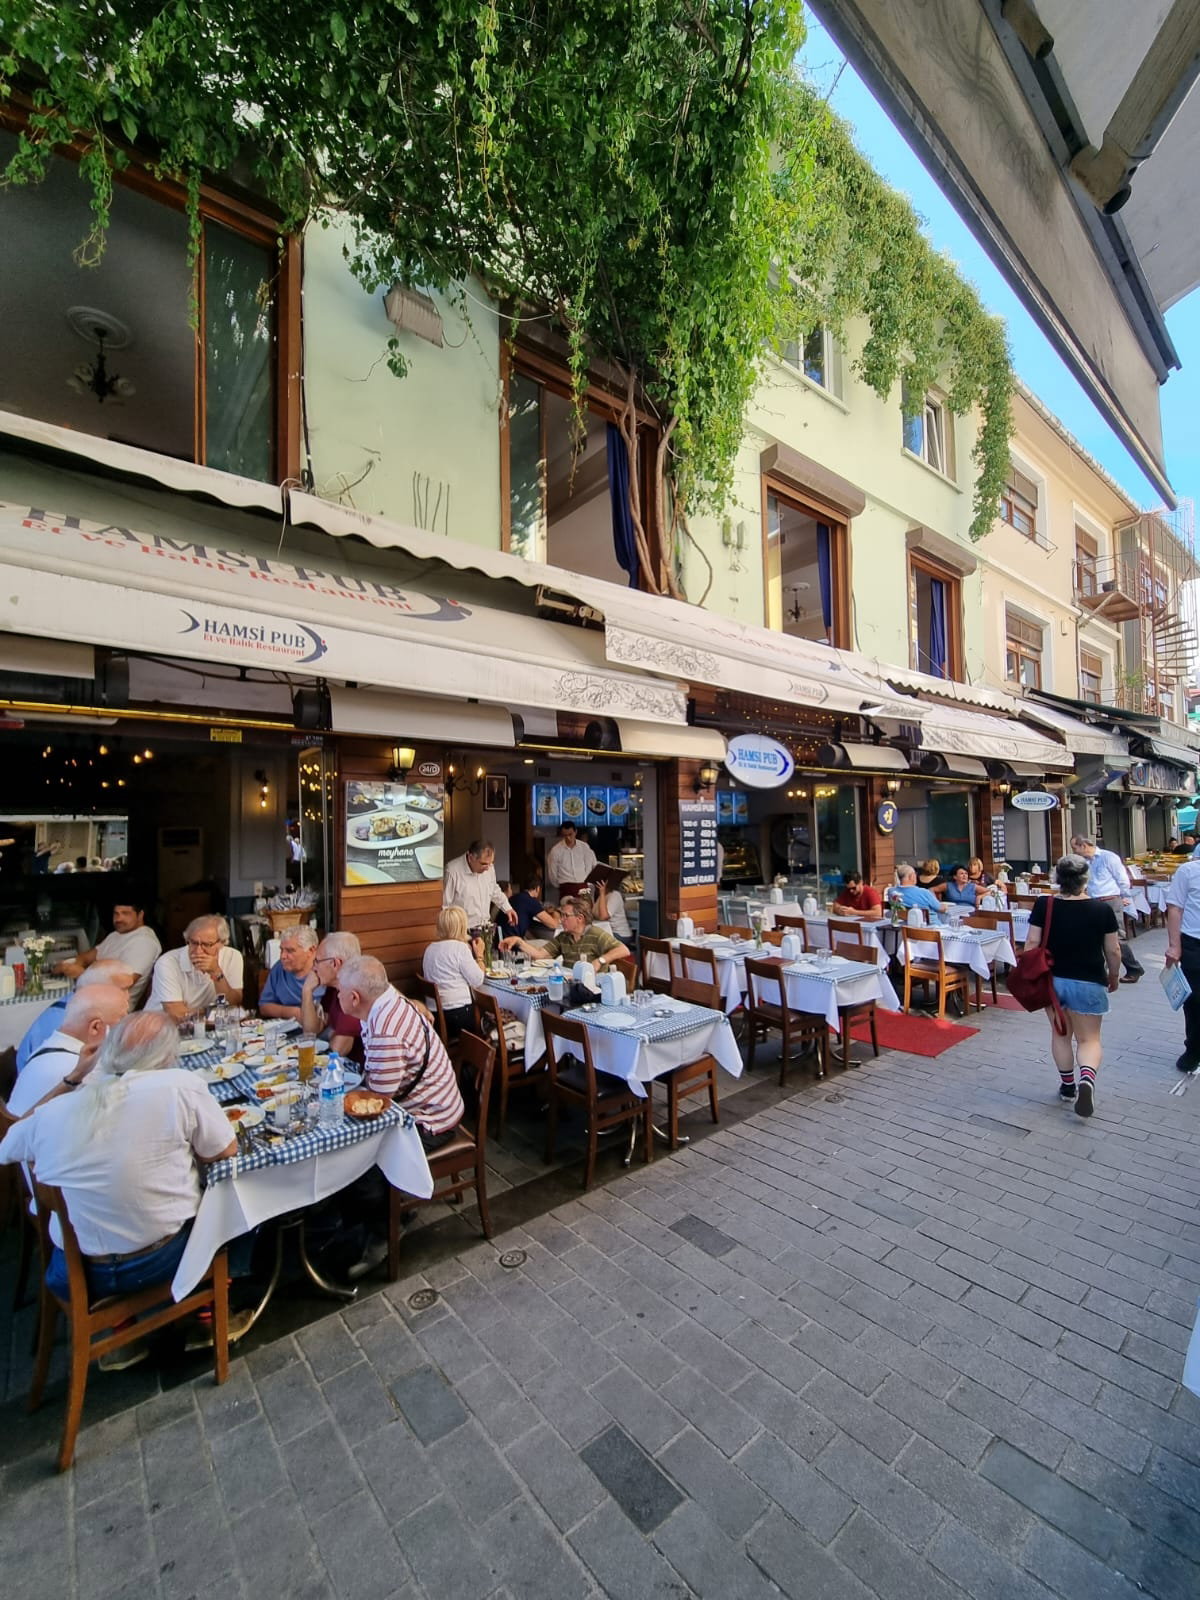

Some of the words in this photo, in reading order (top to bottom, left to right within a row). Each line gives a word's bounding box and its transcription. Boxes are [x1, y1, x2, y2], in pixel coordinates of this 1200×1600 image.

[80, 532, 126, 549] ve
[249, 569, 417, 612] Restaurant
[295, 565, 407, 602] PUB
[203, 633, 214, 643] Et
[215, 635, 227, 644] ve
[256, 640, 305, 657] Restaurant
[204, 618, 265, 642] HAMSİ
[271, 631, 306, 649] PUB
[763, 752, 778, 765] PUB
